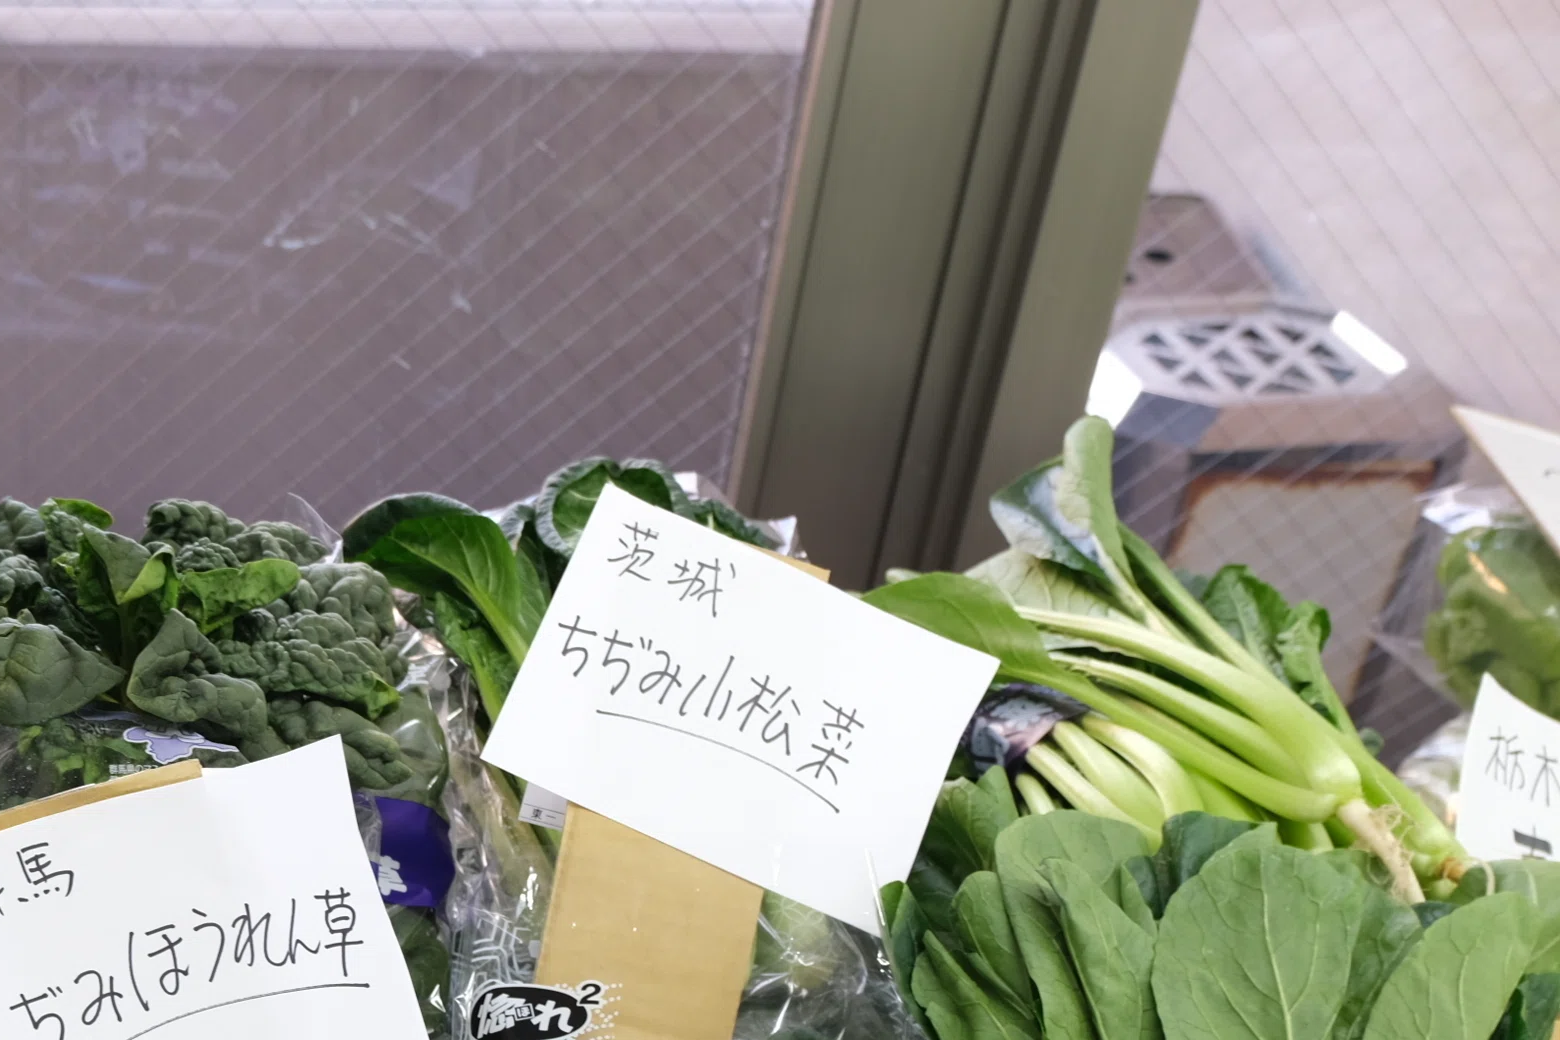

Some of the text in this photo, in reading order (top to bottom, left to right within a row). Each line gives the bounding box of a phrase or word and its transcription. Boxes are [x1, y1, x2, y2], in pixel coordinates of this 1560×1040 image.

[608, 522, 736, 617] 茨城
[558, 615, 864, 785] ちぢみ小松菜
